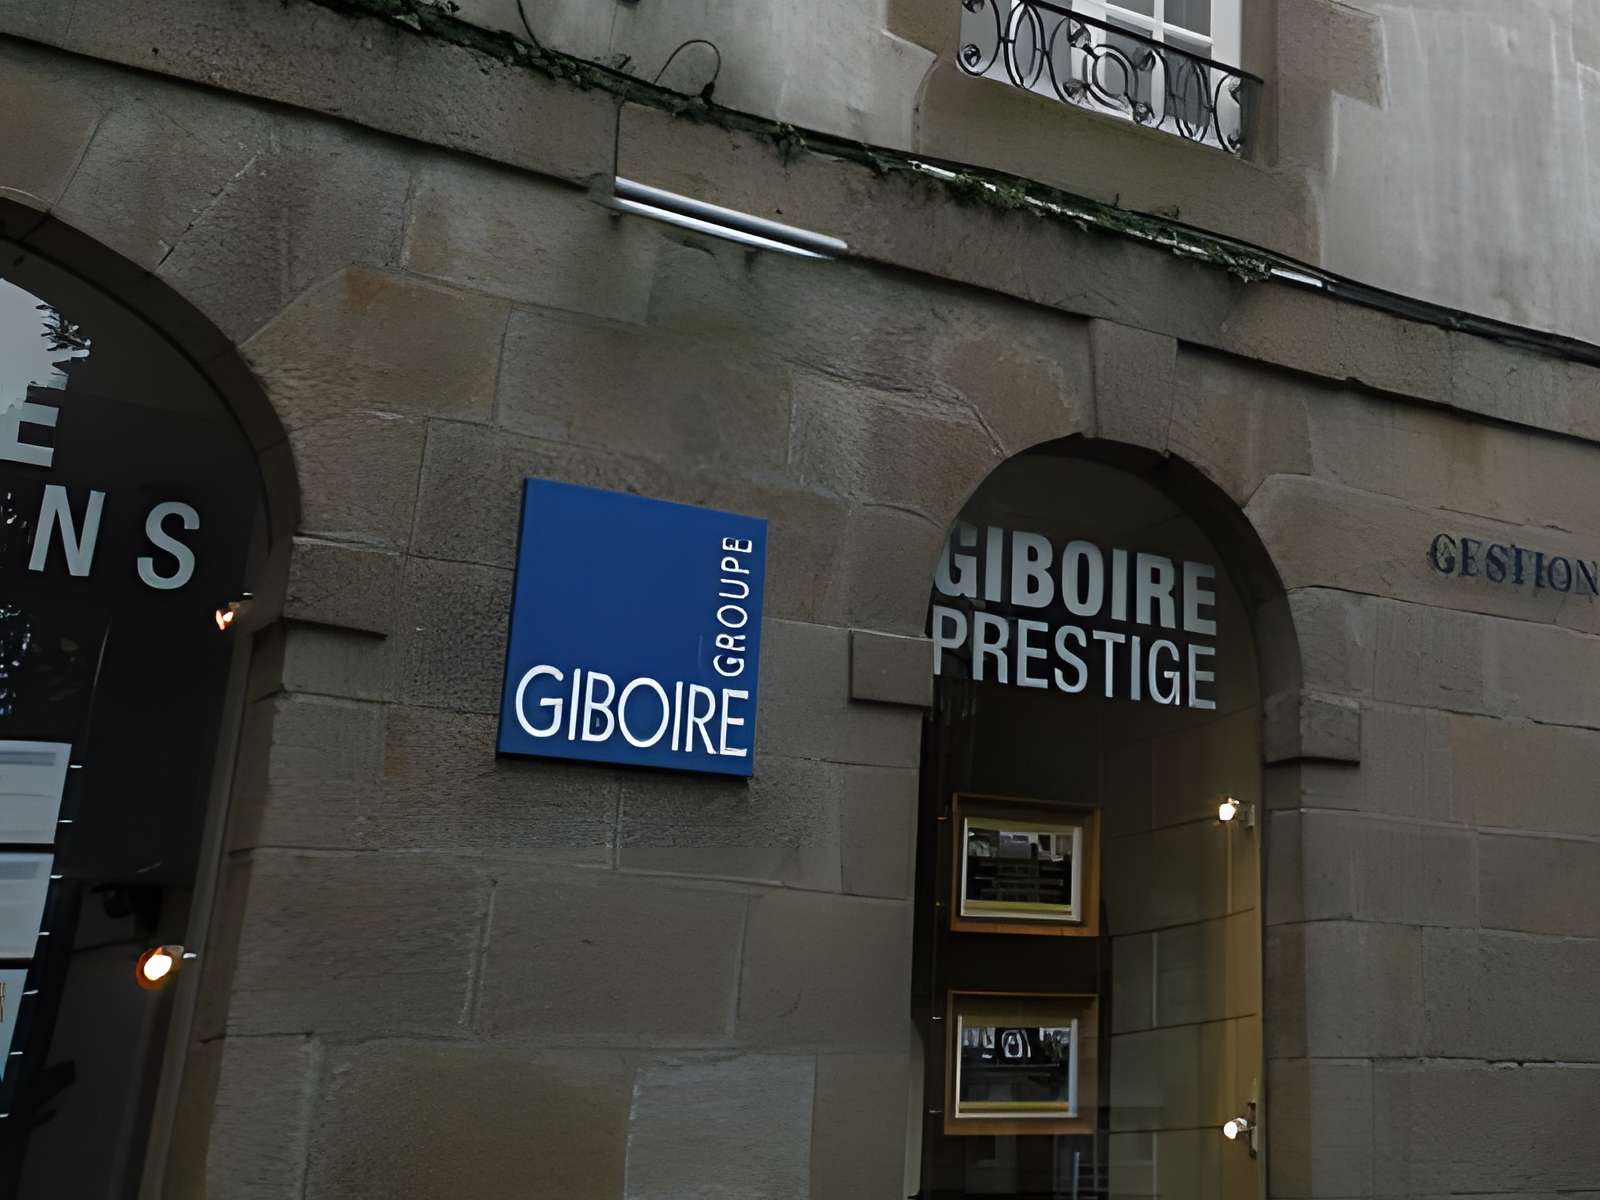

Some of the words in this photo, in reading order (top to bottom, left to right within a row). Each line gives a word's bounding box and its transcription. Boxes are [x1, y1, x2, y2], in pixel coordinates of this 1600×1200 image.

[712, 536, 753, 677] GROUPE
[934, 524, 1217, 636] GIBOIRE
[1428, 533, 1600, 596] GESTION
[932, 605, 1217, 710] PRESTIGE
[515, 664, 749, 757] GIBOIRE
